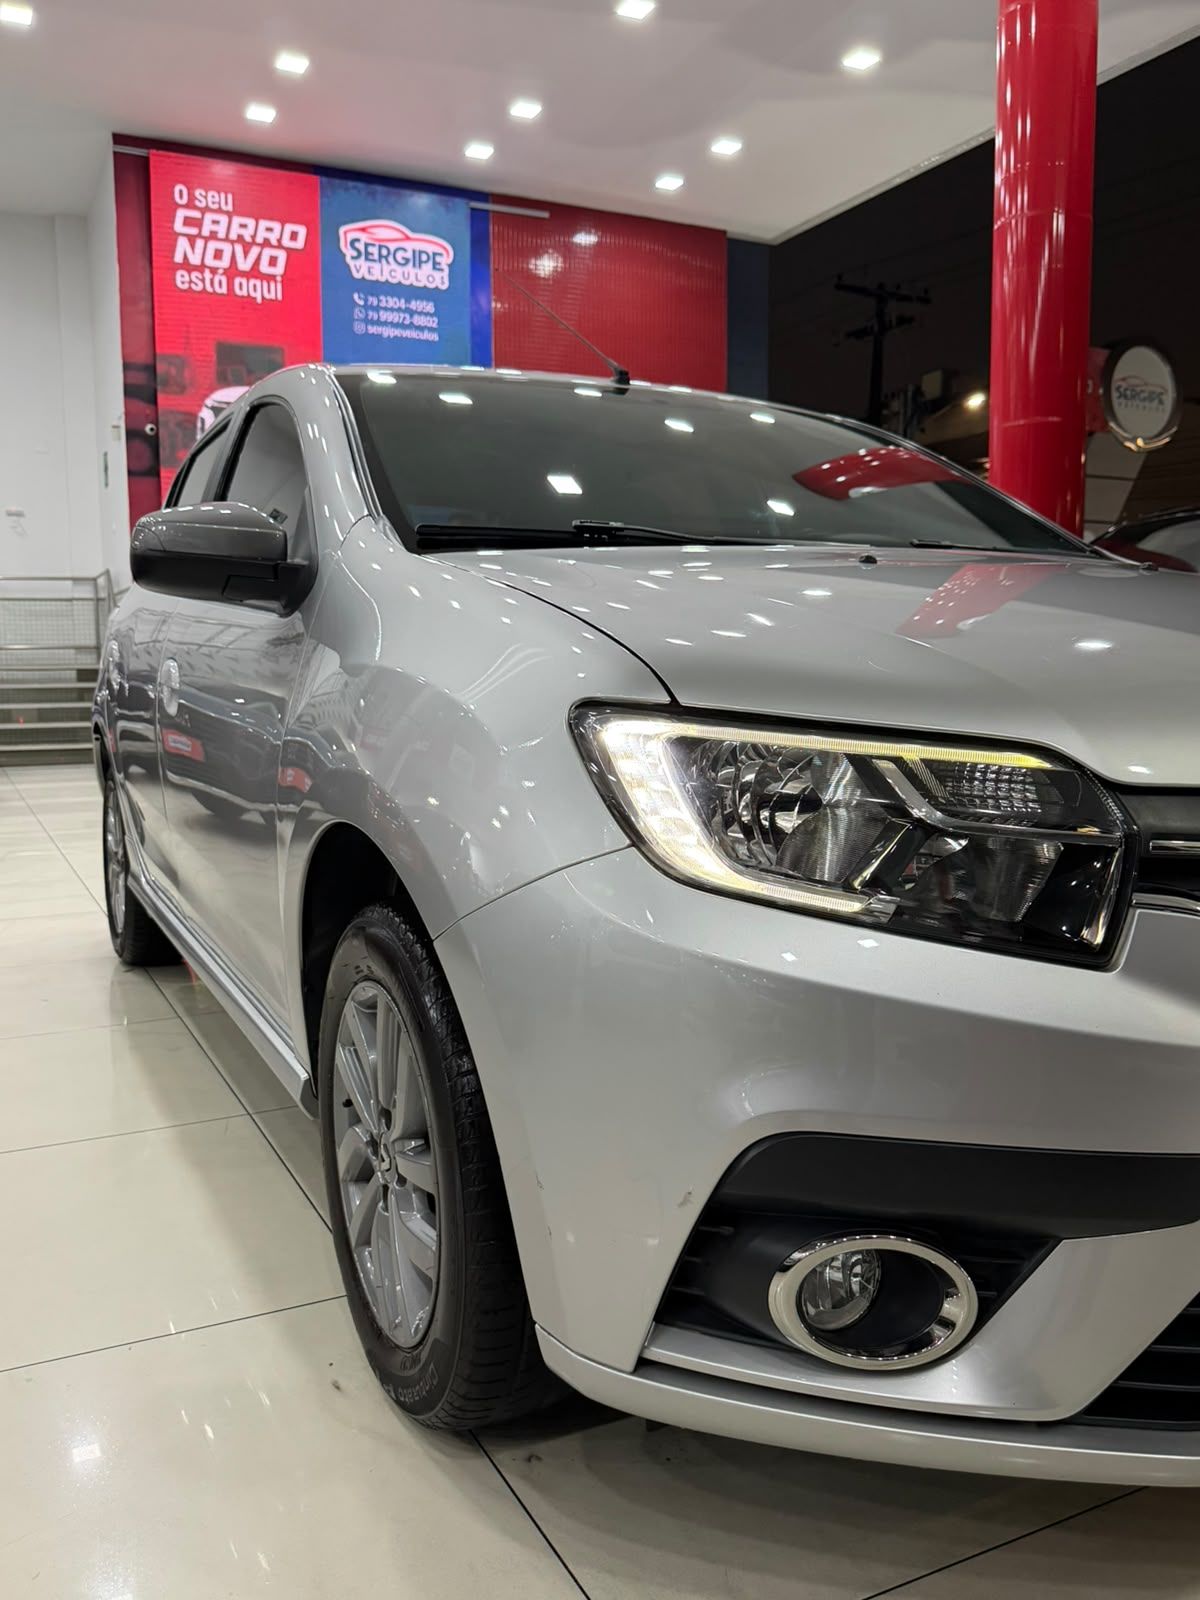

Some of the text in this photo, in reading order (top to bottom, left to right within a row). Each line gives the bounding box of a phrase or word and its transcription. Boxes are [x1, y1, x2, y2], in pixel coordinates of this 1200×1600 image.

[194, 188, 233, 212] seu
[173, 207, 307, 250] CARRO
[173, 235, 288, 276] NOVO
[349, 238, 445, 272] SERGIPE
[175, 268, 283, 304] está aqui
